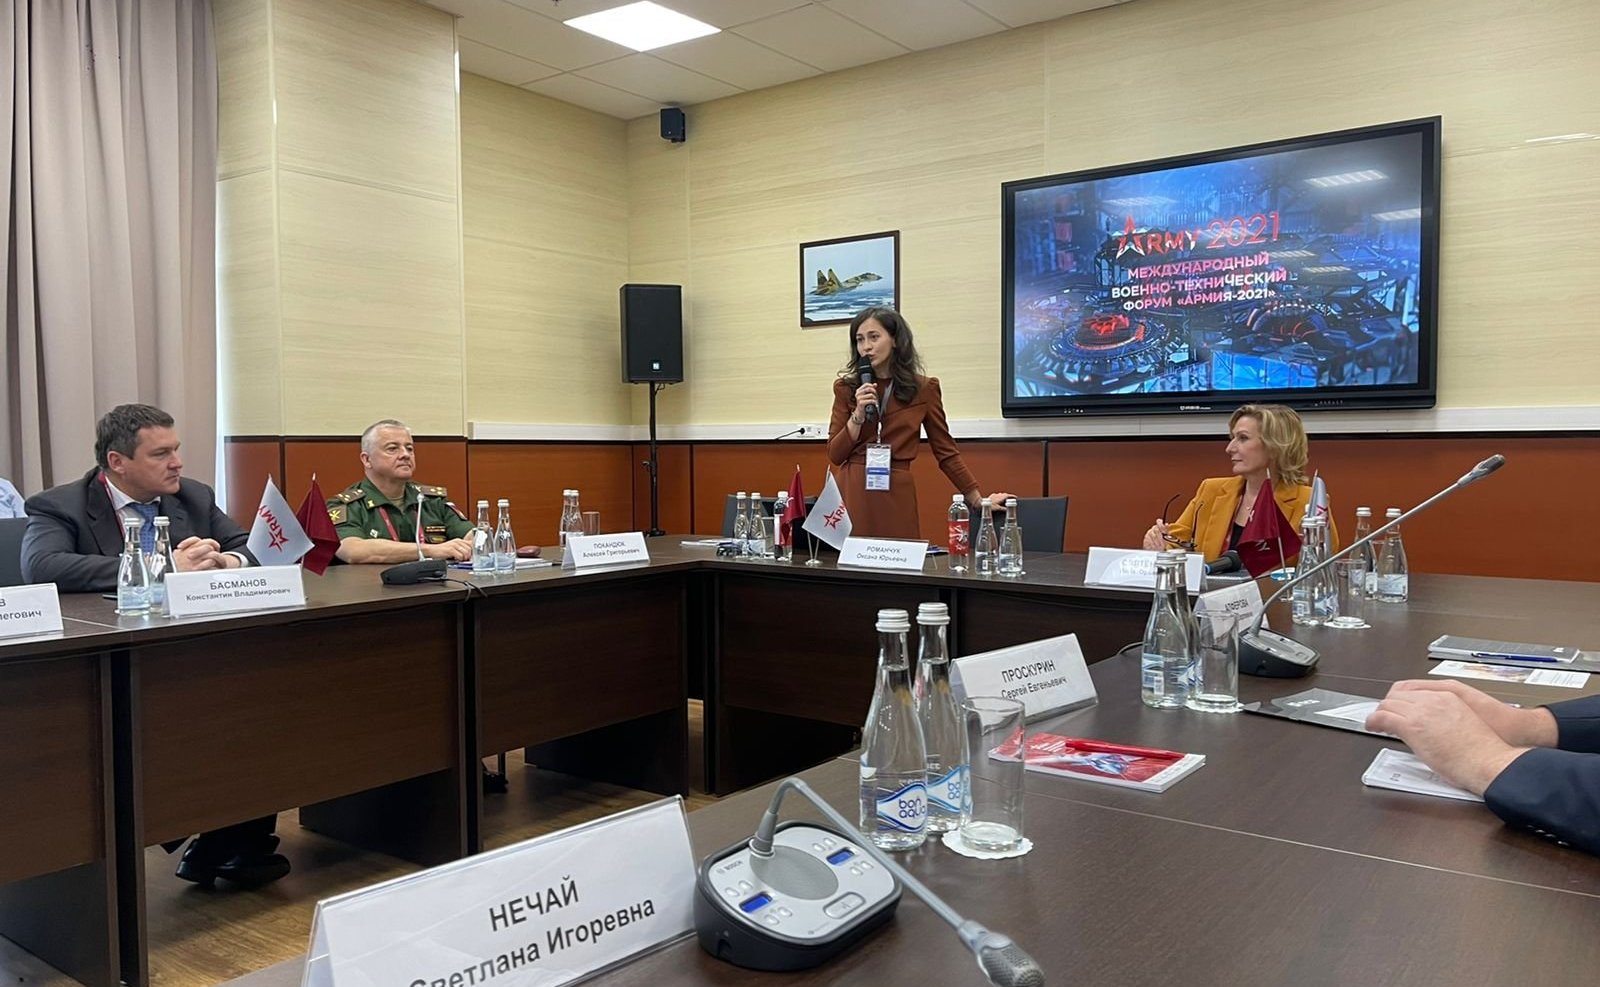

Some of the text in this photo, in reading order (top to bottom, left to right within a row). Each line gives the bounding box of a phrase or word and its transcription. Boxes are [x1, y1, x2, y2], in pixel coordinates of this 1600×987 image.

[1113, 211, 1280, 259] ARMY 2021
[1127, 251, 1270, 280] МЕЖДУНАРОДНЫЙ
[1111, 267, 1287, 299] ВОЕННО-ТЕХНИЧЕСКИЙ
[1123, 288, 1276, 311] ФОРУМ «АРМИЯ-2021»
[879, 554, 907, 562] Юрьевна
[186, 587, 291, 602] Константин Владимирович
[209, 578, 267, 590] БАСМАНОВ
[1001, 659, 1055, 682] ПРОСКУРИН
[1001, 676, 1067, 700] Сергей Евгеньевич
[489, 875, 579, 932] НЕЧАЙ
[546, 898, 656, 955] Игоревна
